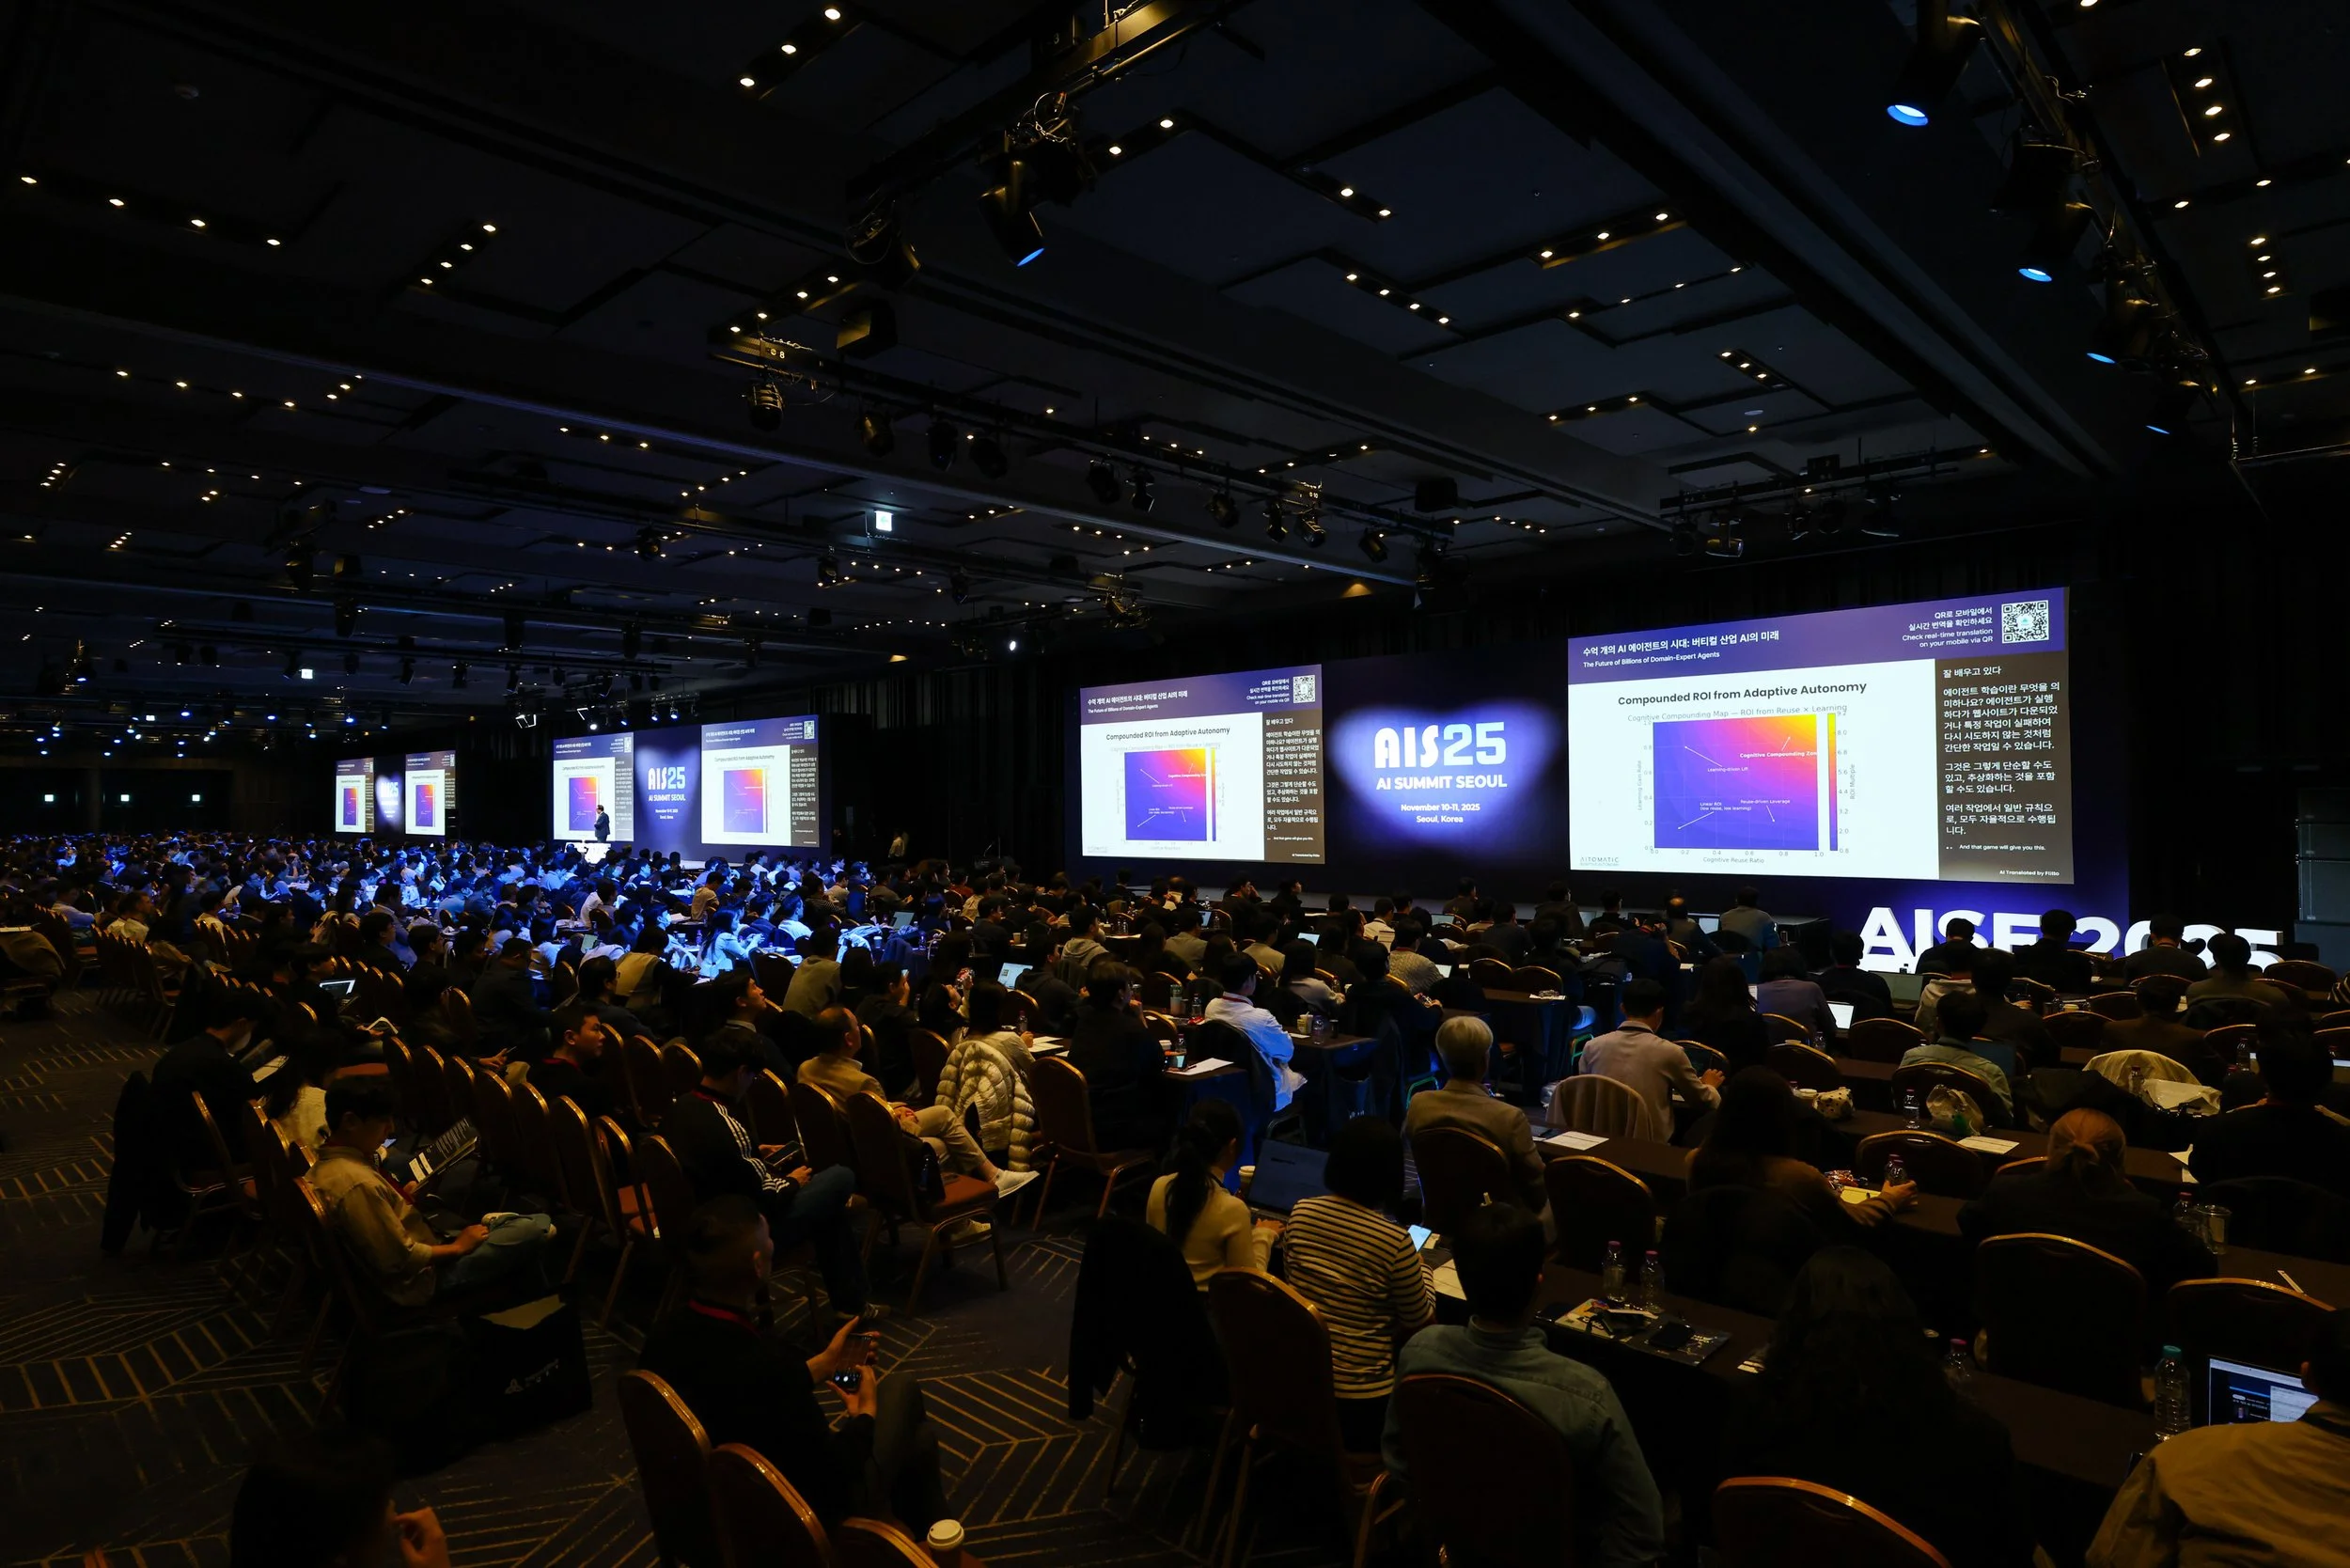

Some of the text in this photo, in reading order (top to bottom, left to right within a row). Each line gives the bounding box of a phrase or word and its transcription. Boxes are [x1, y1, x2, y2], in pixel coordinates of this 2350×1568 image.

[1955, 607, 1992, 618] 모바일에서
[1909, 618, 1992, 632] 실시간 번역을 확인하세요
[1925, 631, 1954, 639] real-time
[1956, 628, 1993, 636] translation
[1584, 647, 1598, 655] 수억
[1628, 641, 1668, 652] 에이전트의
[1670, 638, 1690, 649] 시대:
[1692, 636, 1717, 648] 버티컬
[1720, 635, 1737, 645] 산업
[1740, 632, 1758, 642] AI의
[1761, 631, 1778, 641] 미래
[1946, 637, 1968, 646] mobile
[1651, 653, 1696, 663] Domain-Expert
[1698, 651, 1719, 660] Agents
[1943, 666, 2001, 678] 잘 배우고 있다
[1618, 682, 1867, 706] Compounded ROI from Adaptive Autonomy
[1943, 682, 2060, 697] 에이전트 학습이란 무엇을 의
[1944, 694, 2053, 708] 미하나요? 에이전트가 실행
[1628, 713, 1659, 722] Cognitive
[1662, 711, 1711, 721] Compounding
[1713, 710, 1729, 718] Map
[1777, 706, 1800, 714] Reuse
[1811, 704, 1847, 713] Learning
[1944, 705, 2058, 718] 하다가 웹사이트가 다운되었
[1964, 720, 1981, 729] 특정
[1984, 719, 2011, 729] 작업이
[2014, 717, 2051, 728] 실패하여
[1106, 732, 1143, 741] Compounded
[1170, 729, 1197, 737] Adaptive
[1198, 727, 1230, 736] Autonomy
[1944, 729, 2051, 741] 다시 시도하지 않는 것처럼
[1374, 722, 1506, 768] AIS25
[1945, 741, 2054, 752] 간단한 작업일 수 있습니다.
[1945, 760, 2052, 771] 그것은 그렇게 단순할 수도
[649, 767, 685, 790] AIS25
[1376, 775, 1507, 790] AI SUMMIT SEOUL
[1945, 772, 2055, 783] 있고, 추상화하는 것을 포함
[1946, 785, 1953, 793] 할
[1977, 784, 2014, 792] 있습니다.
[1946, 804, 2053, 812] 여러 작업에서 일반 규칙으
[1960, 815, 1977, 823] 모두
[1980, 815, 2025, 823] 자율적으로
[2028, 815, 2056, 823] 수행됩
[1947, 826, 1966, 835] 니다.
